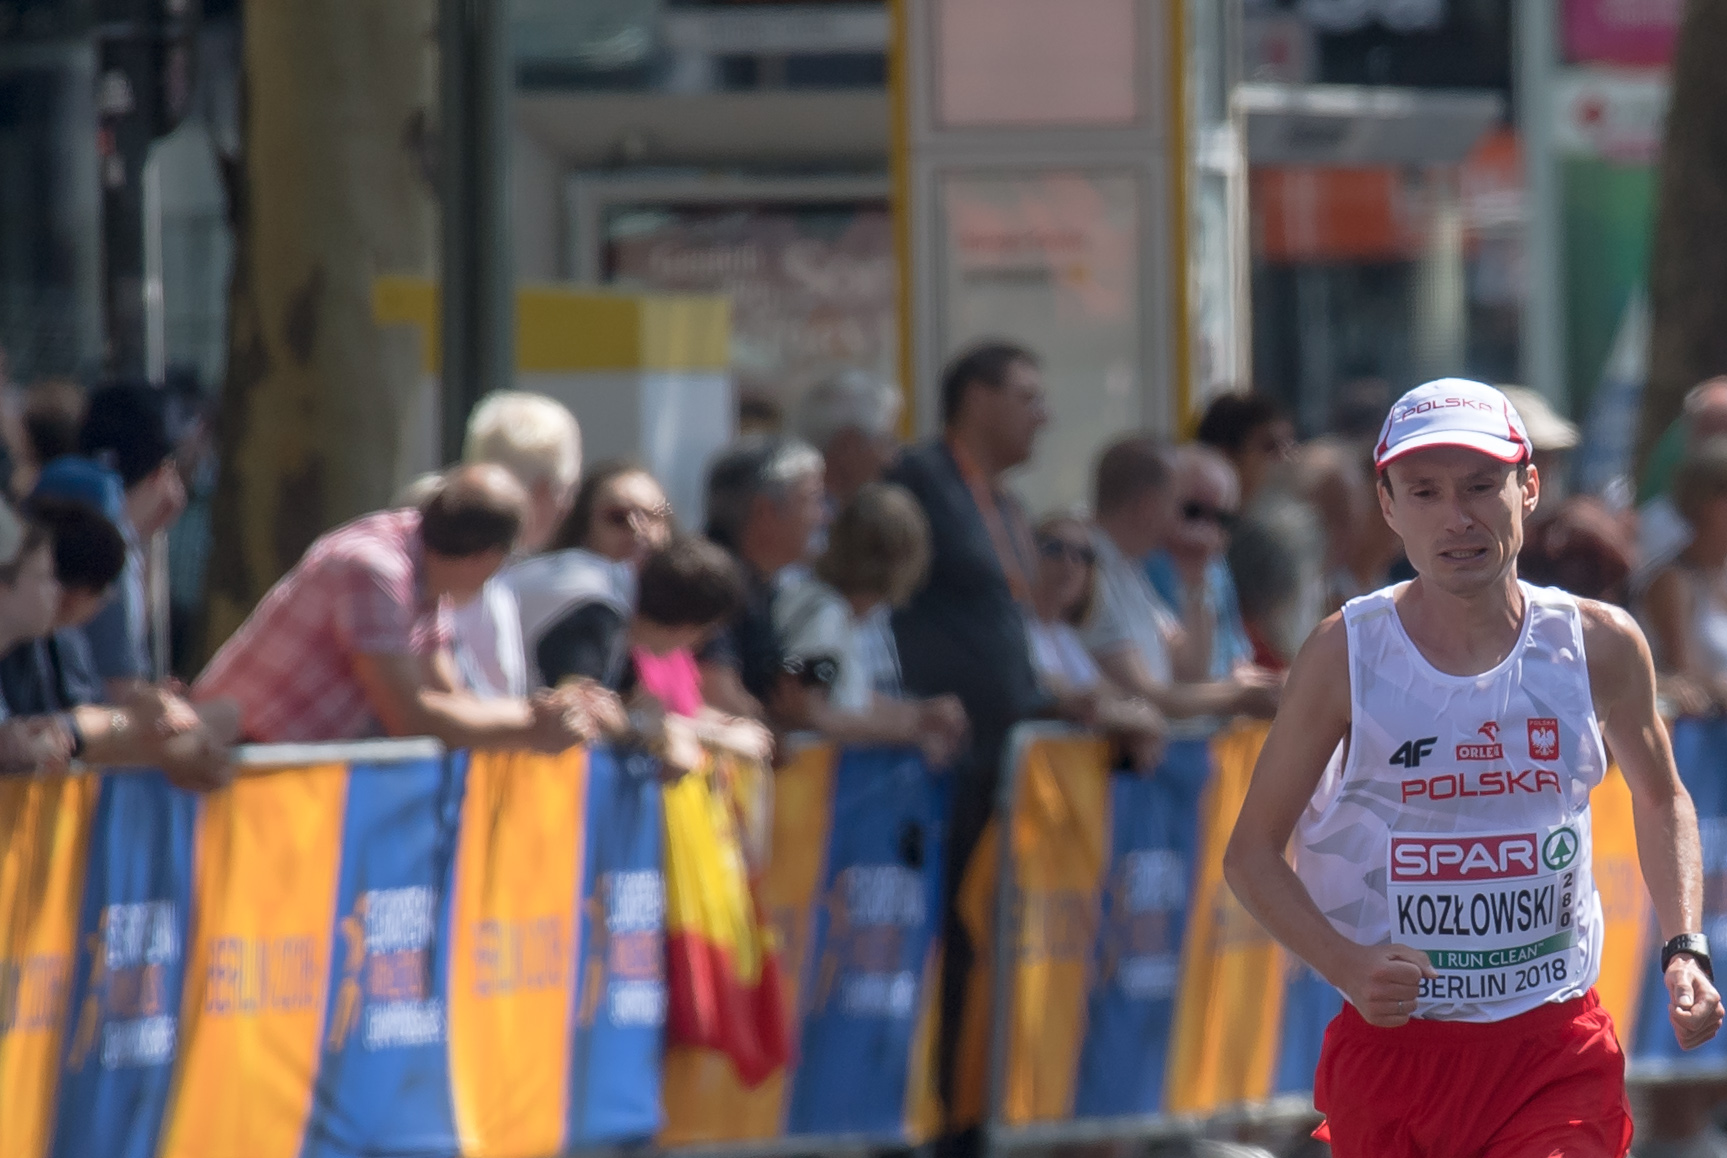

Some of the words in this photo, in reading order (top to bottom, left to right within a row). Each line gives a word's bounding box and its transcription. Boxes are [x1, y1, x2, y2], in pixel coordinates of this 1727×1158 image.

[1402, 398, 1493, 421] POLSKA
[1529, 719, 1556, 727] POLSKA
[1389, 736, 1438, 768] 4F
[1401, 769, 1562, 804] POLSKA
[1394, 839, 1535, 876] SPAR
[1397, 884, 1555, 936] KOZŁOWSKI
[1438, 952, 1443, 967] I
[1447, 952, 1484, 968] RUN
[1418, 972, 1507, 999] BERLIN
[1514, 957, 1568, 993] 2018
